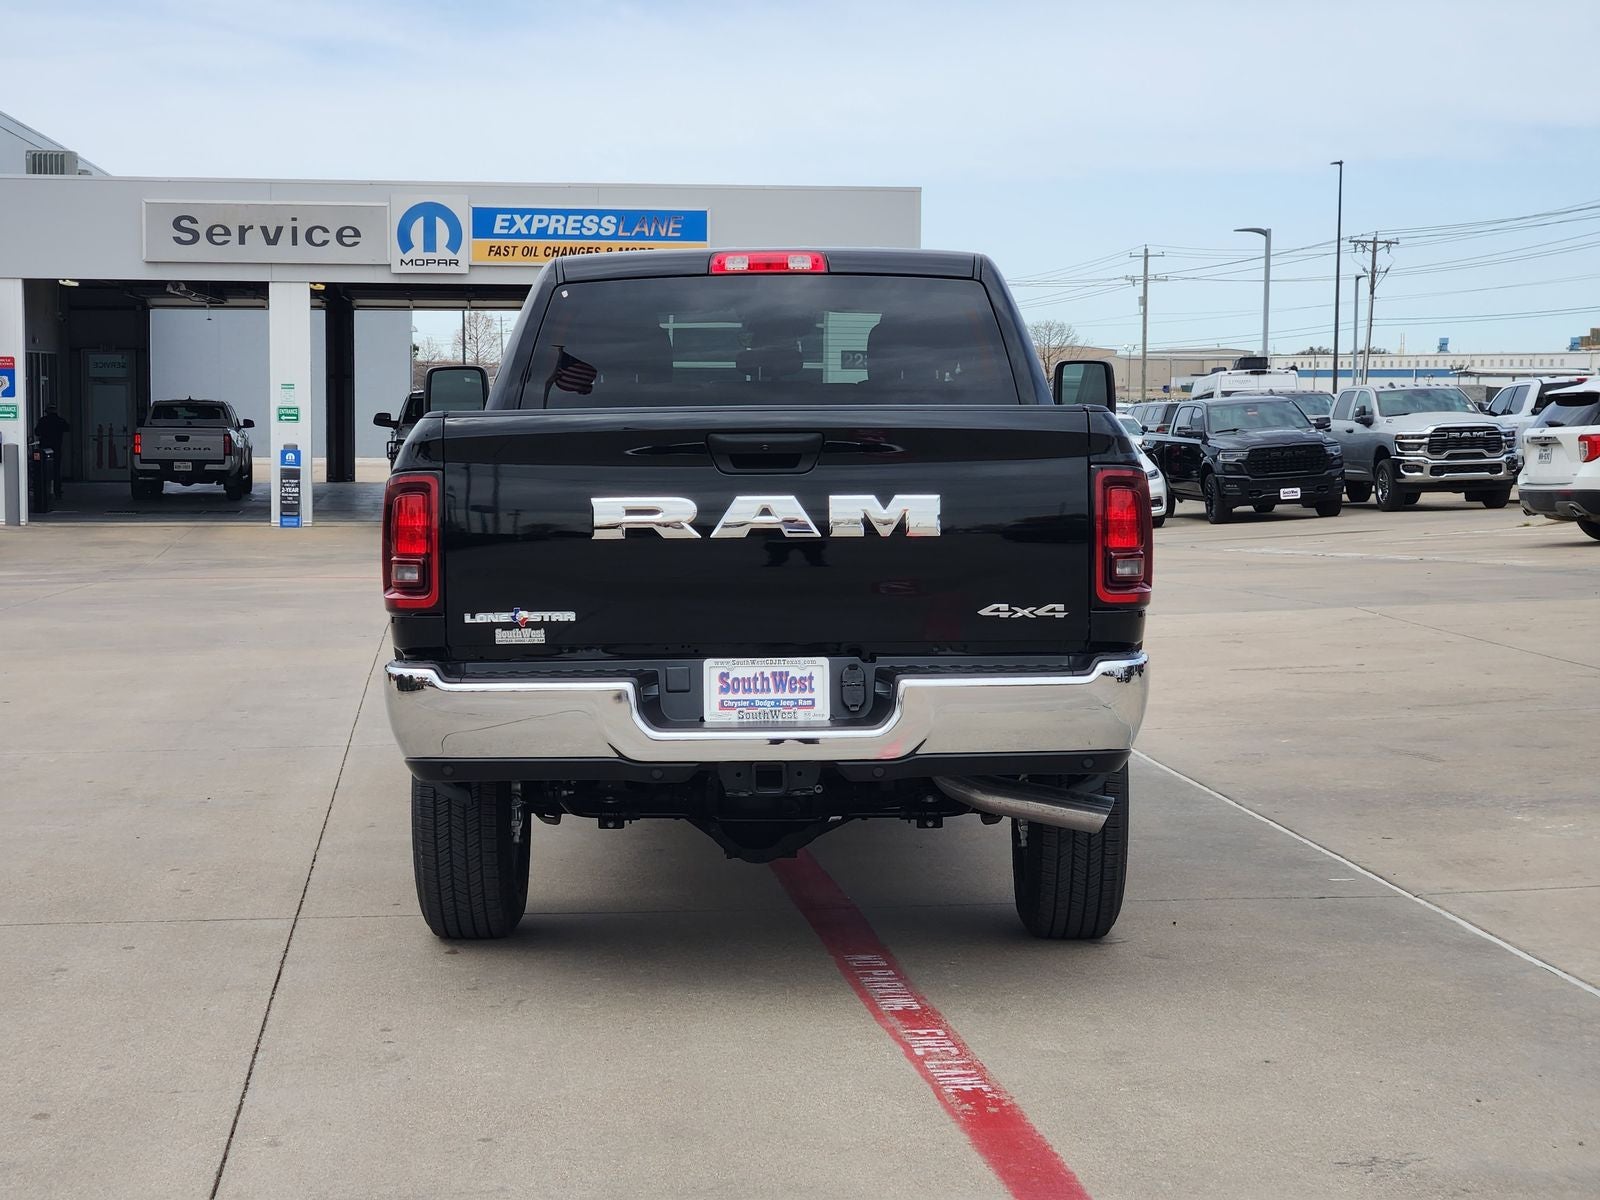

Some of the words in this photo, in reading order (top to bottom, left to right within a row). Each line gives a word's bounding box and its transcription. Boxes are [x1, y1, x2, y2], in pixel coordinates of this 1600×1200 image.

[172, 214, 361, 247] Service
[487, 245, 518, 257] FAST
[521, 245, 539, 257] OIL
[400, 258, 460, 267] MOPAR
[591, 494, 941, 540] RAM
[977, 603, 1070, 618] 4x4
[464, 612, 511, 623] LONE
[528, 611, 576, 622] STAR
[495, 628, 545, 638] SouthWest
[718, 671, 815, 694] SouthWest
[723, 700, 750, 708] Chrysler
[737, 709, 798, 719] SouthWest
